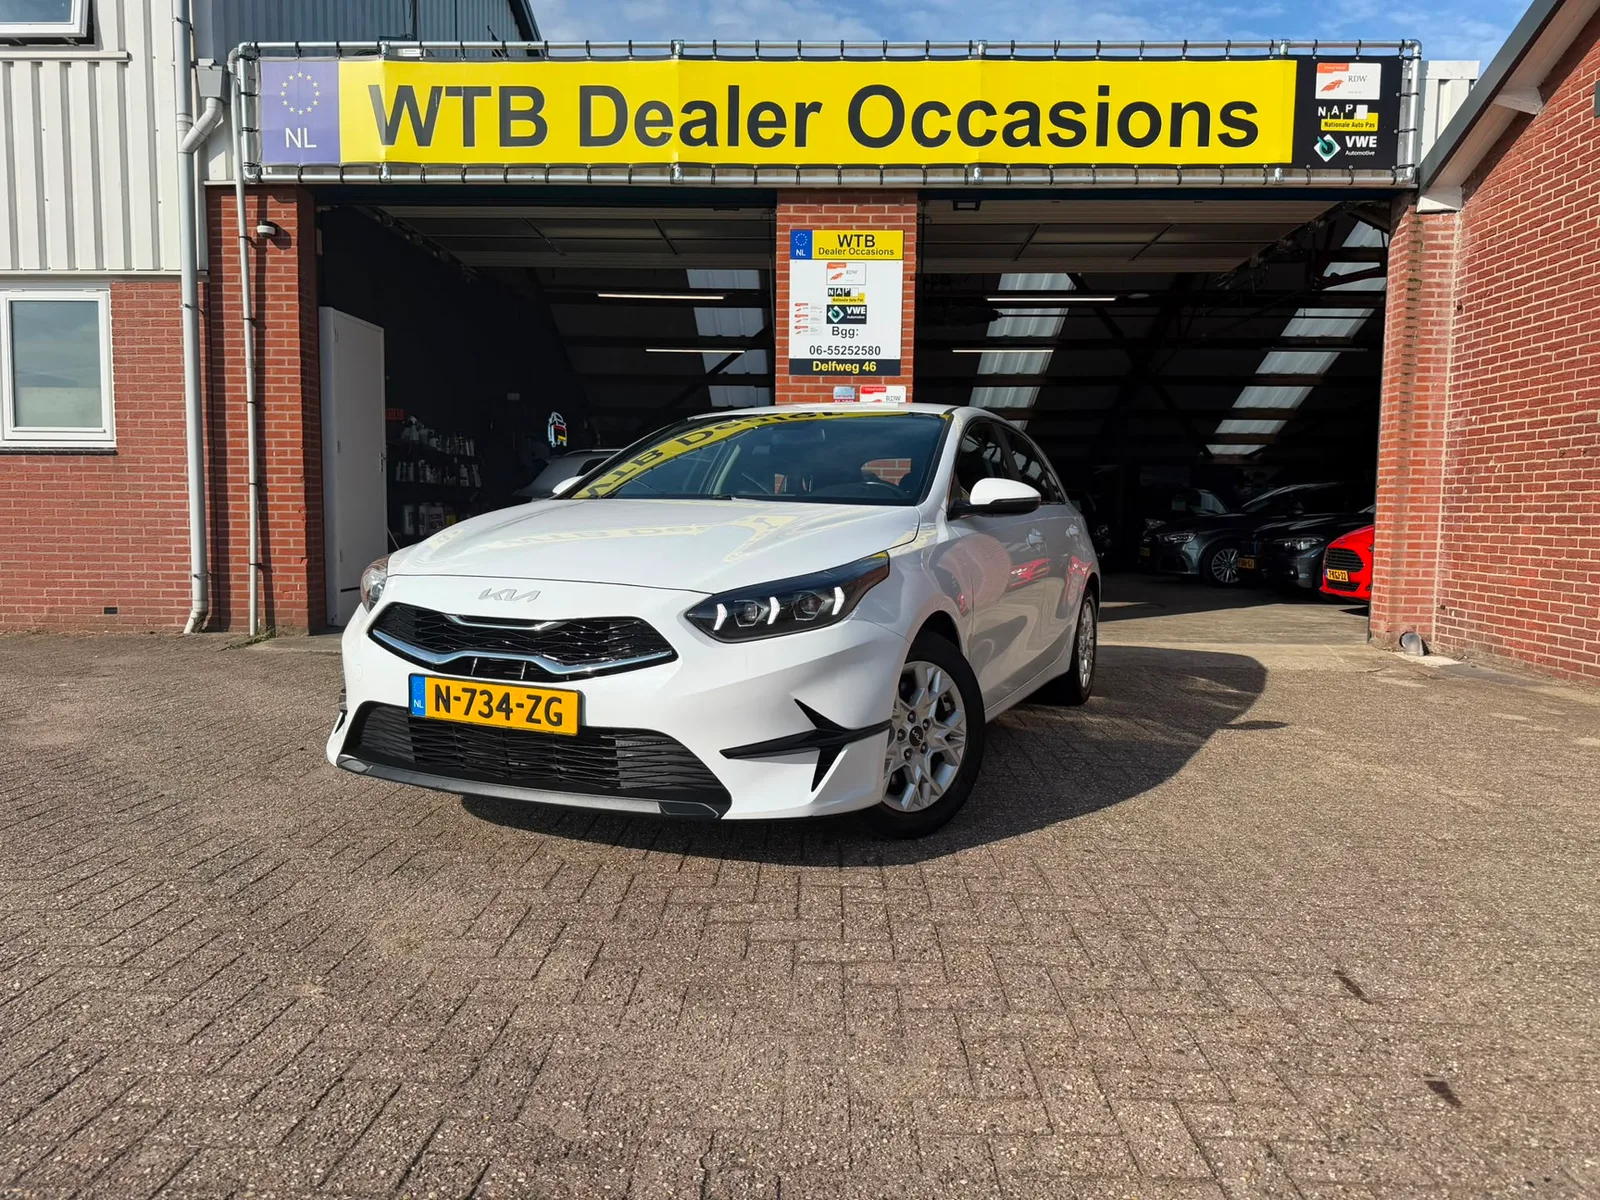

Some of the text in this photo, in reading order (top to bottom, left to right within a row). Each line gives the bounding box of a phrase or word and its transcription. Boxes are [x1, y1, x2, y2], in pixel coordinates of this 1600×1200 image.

[1348, 75, 1368, 83] RDW
[368, 83, 1259, 149] WTB Dealer Occasions
[1365, 121, 1375, 129] Pas
[284, 126, 317, 149] NL
[1345, 135, 1377, 148] VWE
[837, 233, 876, 248] WTB
[795, 249, 806, 257] NL
[818, 247, 895, 256] Dealer Occasions
[846, 306, 866, 314] VWE
[831, 326, 859, 339] Bgg:
[809, 345, 881, 356] 06-55252580
[812, 361, 877, 374] Delfweg 46
[413, 699, 424, 709] NL
[434, 683, 563, 727] N-734-ZG
